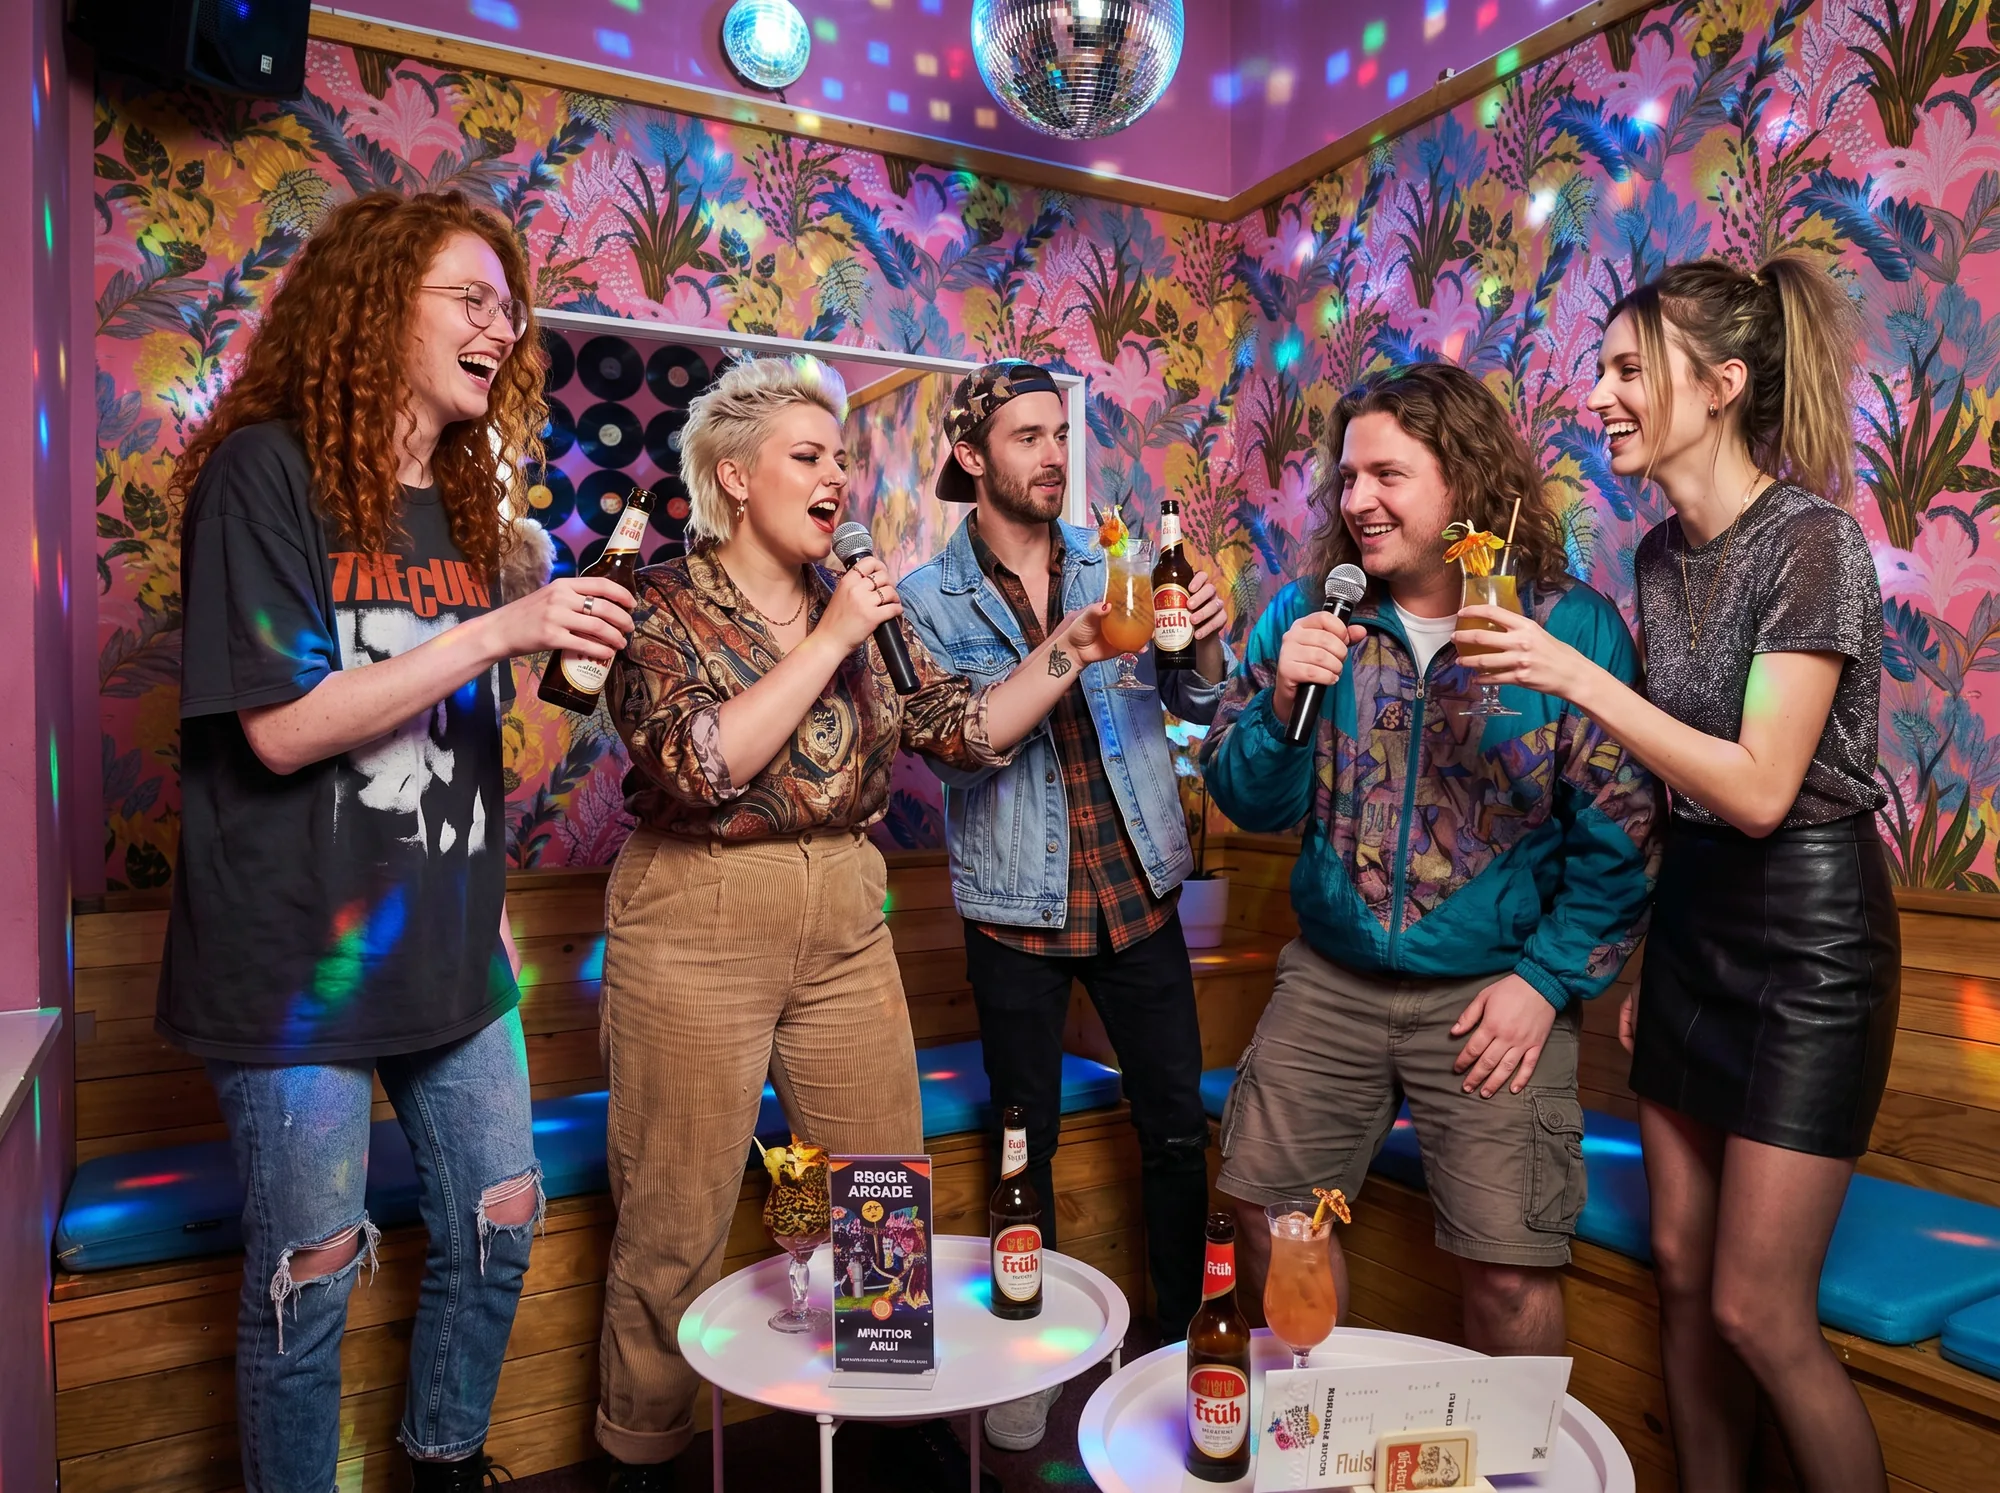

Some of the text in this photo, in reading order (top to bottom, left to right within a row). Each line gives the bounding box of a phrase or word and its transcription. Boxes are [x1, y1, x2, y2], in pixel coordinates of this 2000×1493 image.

[1001, 1253, 1038, 1273] Früh
[1207, 1260, 1232, 1277] Früh
[1194, 1397, 1241, 1426] Früh
